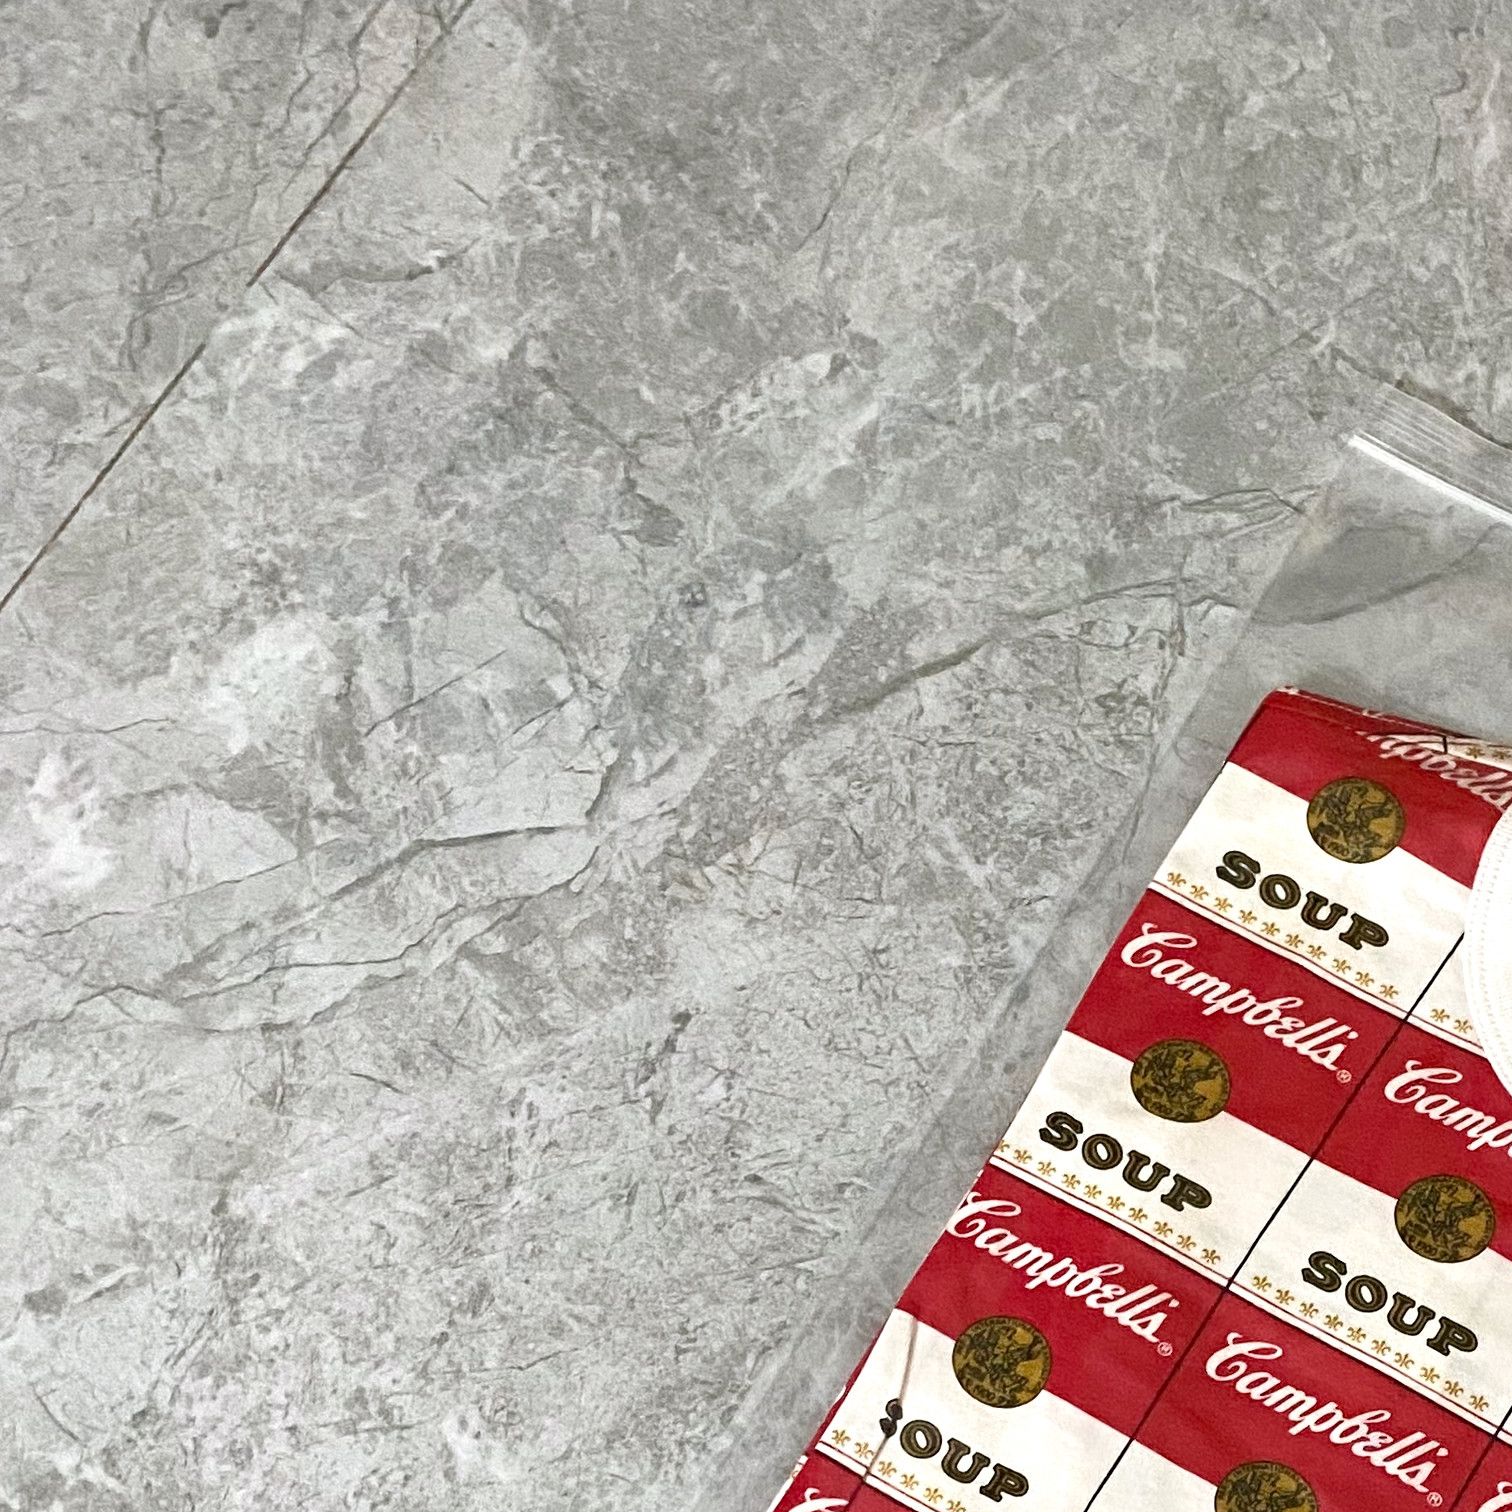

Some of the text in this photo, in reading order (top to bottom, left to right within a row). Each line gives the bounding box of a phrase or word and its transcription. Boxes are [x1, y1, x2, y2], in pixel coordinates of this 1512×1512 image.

[1216, 851, 1389, 950] SOUP
[1121, 923, 1358, 1070] Campbell's
[1039, 1112, 1212, 1211] SOUP
[946, 1191, 1179, 1343] Campbell's
[1302, 1251, 1478, 1356] SOUP
[1206, 1333, 1448, 1492] Campbell's
